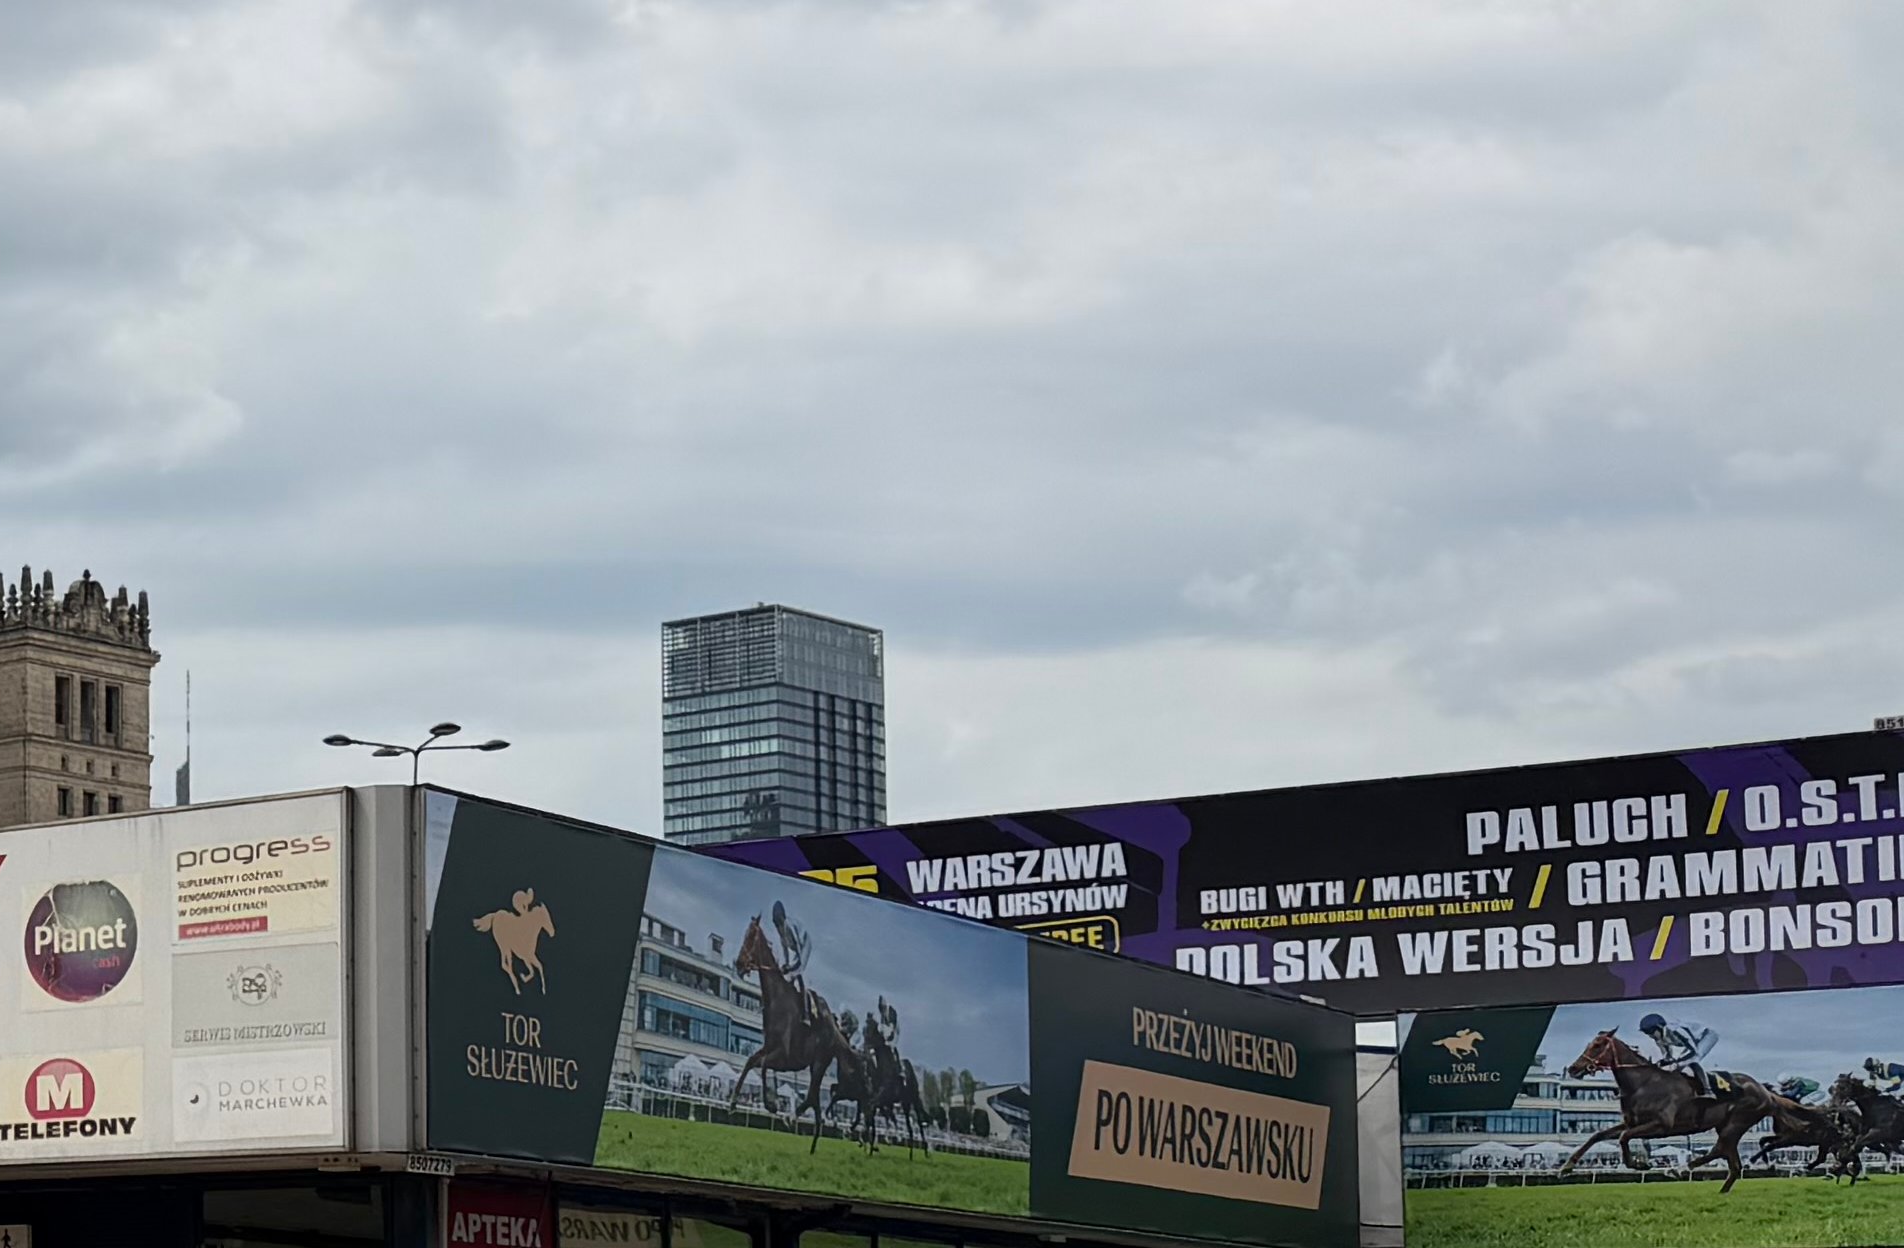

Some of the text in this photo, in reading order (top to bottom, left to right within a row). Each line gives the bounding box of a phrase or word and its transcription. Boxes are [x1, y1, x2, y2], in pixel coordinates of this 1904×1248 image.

[1466, 771, 1904, 856] PALUCH / O.S.T.
[177, 835, 331, 872] progress
[905, 842, 1128, 895] WARSZAWA
[1200, 834, 1904, 914] BUGI WTH / MACIĘTY / GRAMMATI
[998, 884, 1128, 919] URSYNÓW
[1291, 909, 1364, 927] KONKURSU
[1440, 897, 1514, 917] TALENTÓW
[34, 918, 127, 955] Planet
[1396, 917, 1634, 976] WERSJA
[1649, 915, 1675, 960] /
[1689, 896, 1904, 958] BONSO
[184, 1021, 326, 1043] SERWIS MISTRZOWSKI
[501, 1012, 541, 1048] TOR
[1132, 1007, 1297, 1079] PRZEŻYJ WEEKEND
[467, 1044, 578, 1090] SŁUŻEWIEC
[1452, 1063, 1476, 1073] TOR
[36, 1072, 84, 1111] M
[218, 1075, 328, 1097] DOKTOR
[219, 1095, 328, 1112] MARCHEWKA
[1094, 1088, 1314, 1184] PO WARSZAWSKU
[409, 1155, 452, 1174] 8507279
[451, 1211, 542, 1248] APTEKA
